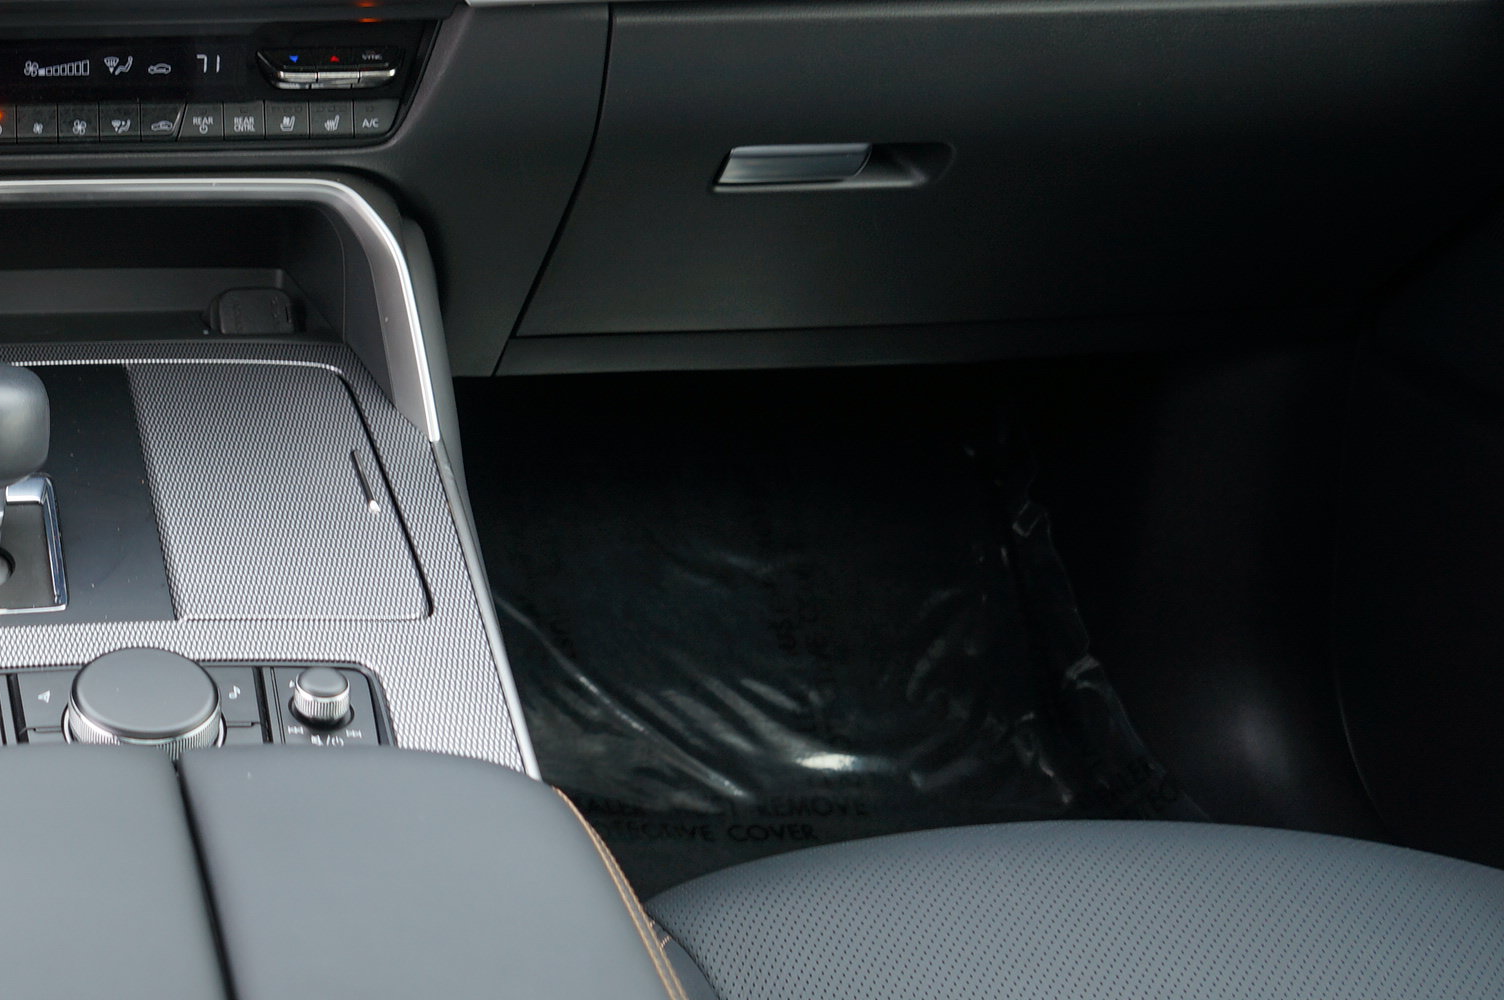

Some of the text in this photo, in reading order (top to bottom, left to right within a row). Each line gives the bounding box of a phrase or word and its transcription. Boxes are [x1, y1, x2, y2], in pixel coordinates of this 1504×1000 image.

[196, 54, 220, 74] 71
[192, 116, 214, 126] REAR
[233, 116, 255, 125] REAR
[362, 118, 379, 129] A/C
[727, 823, 819, 842] COVER
